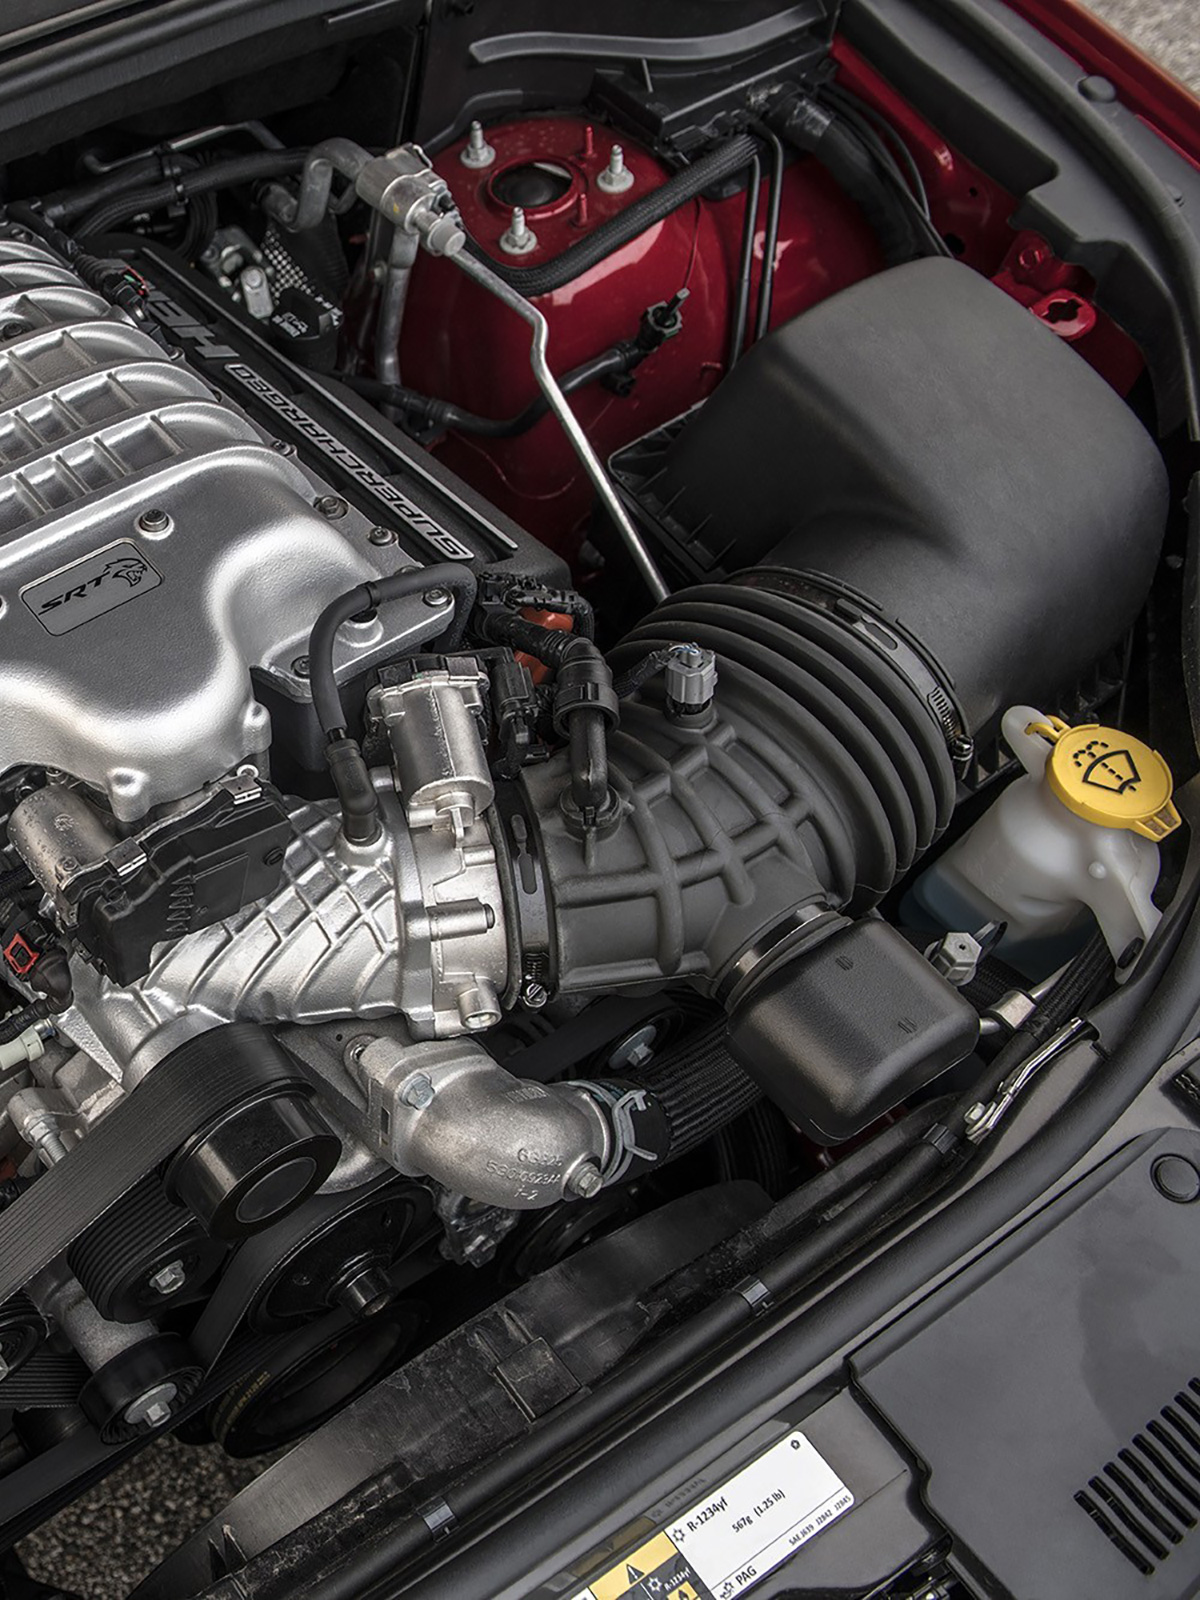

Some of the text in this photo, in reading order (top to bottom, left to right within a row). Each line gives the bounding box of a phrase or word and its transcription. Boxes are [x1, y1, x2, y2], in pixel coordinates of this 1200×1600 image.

[147, 281, 239, 358] HE
[229, 367, 469, 556] SUPERCHARGED
[38, 570, 111, 616] SRT
[686, 1496, 729, 1532] R-1234yf
[732, 1489, 786, 1533] 567g (1.25 lb)
[788, 1495, 852, 1546] SAE J639 J2842 J2845
[663, 1566, 692, 1592] R-1234yf
[735, 1565, 757, 1586] PAG
